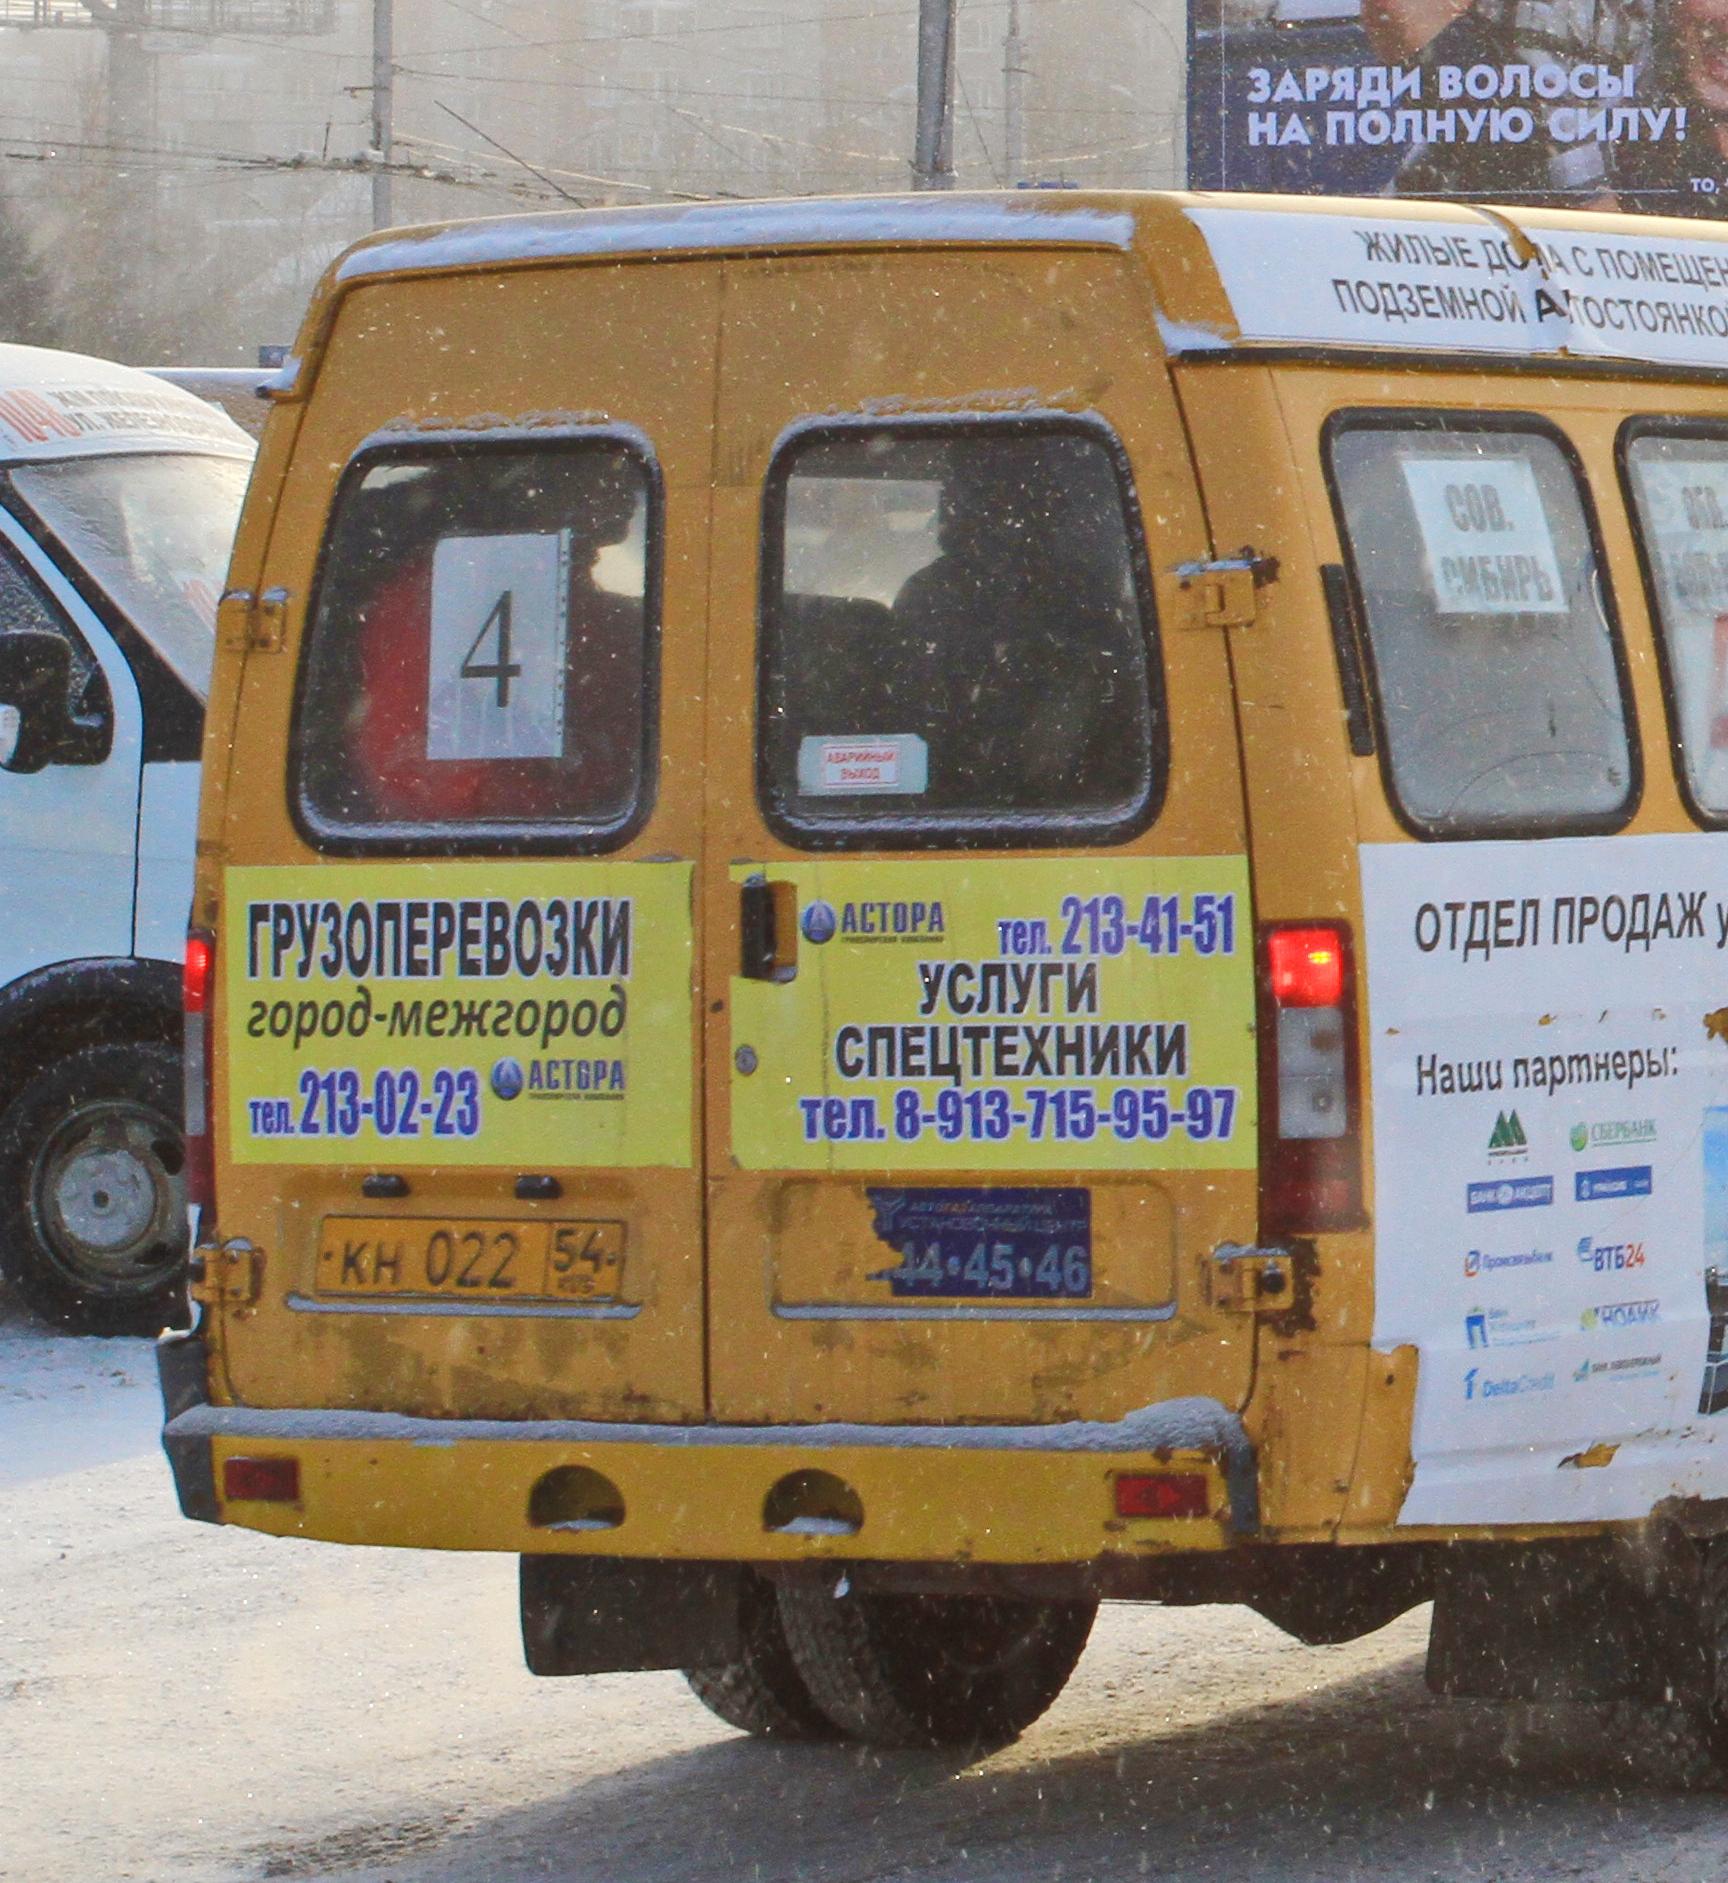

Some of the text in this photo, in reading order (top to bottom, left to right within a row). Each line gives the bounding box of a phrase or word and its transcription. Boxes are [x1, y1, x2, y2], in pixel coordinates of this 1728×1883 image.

[1247, 64, 1635, 110] ЗАРЯДИ ВОЛОСЫ
[1248, 107, 1687, 146] НА ПОЛНУЮ СИЛУ!
[1691, 178, 1720, 195] ТО,
[1353, 230, 1474, 269] ЖИЛЫЕ
[1578, 247, 1593, 276] С
[1332, 278, 1527, 325] ПОДЗЕМНОЙ
[460, 590, 522, 708] 4
[248, 899, 632, 978] ГРУЗОПЕРЕВОЗКИ
[841, 902, 945, 934] АСТОРА
[999, 895, 1235, 956] тел. 213-41-51
[1414, 898, 1541, 962] ОТДЕЛ
[1553, 890, 1708, 953] ПРОДАЖ
[918, 962, 1098, 1015] УСЛУГИ
[247, 984, 628, 1049] город-межгород
[528, 1059, 625, 1090] АСТОРА
[835, 1024, 1187, 1087] СПЕЦТЕХНИКИ
[1416, 1047, 1679, 1097] Наши партнеры:
[249, 1069, 481, 1136] тел. 213-02-23
[800, 1089, 1236, 1141] тел. 8-913-715-95-97
[340, 1228, 604, 1288] КН 022 54
[1593, 1242, 1646, 1273] ВТБ24
